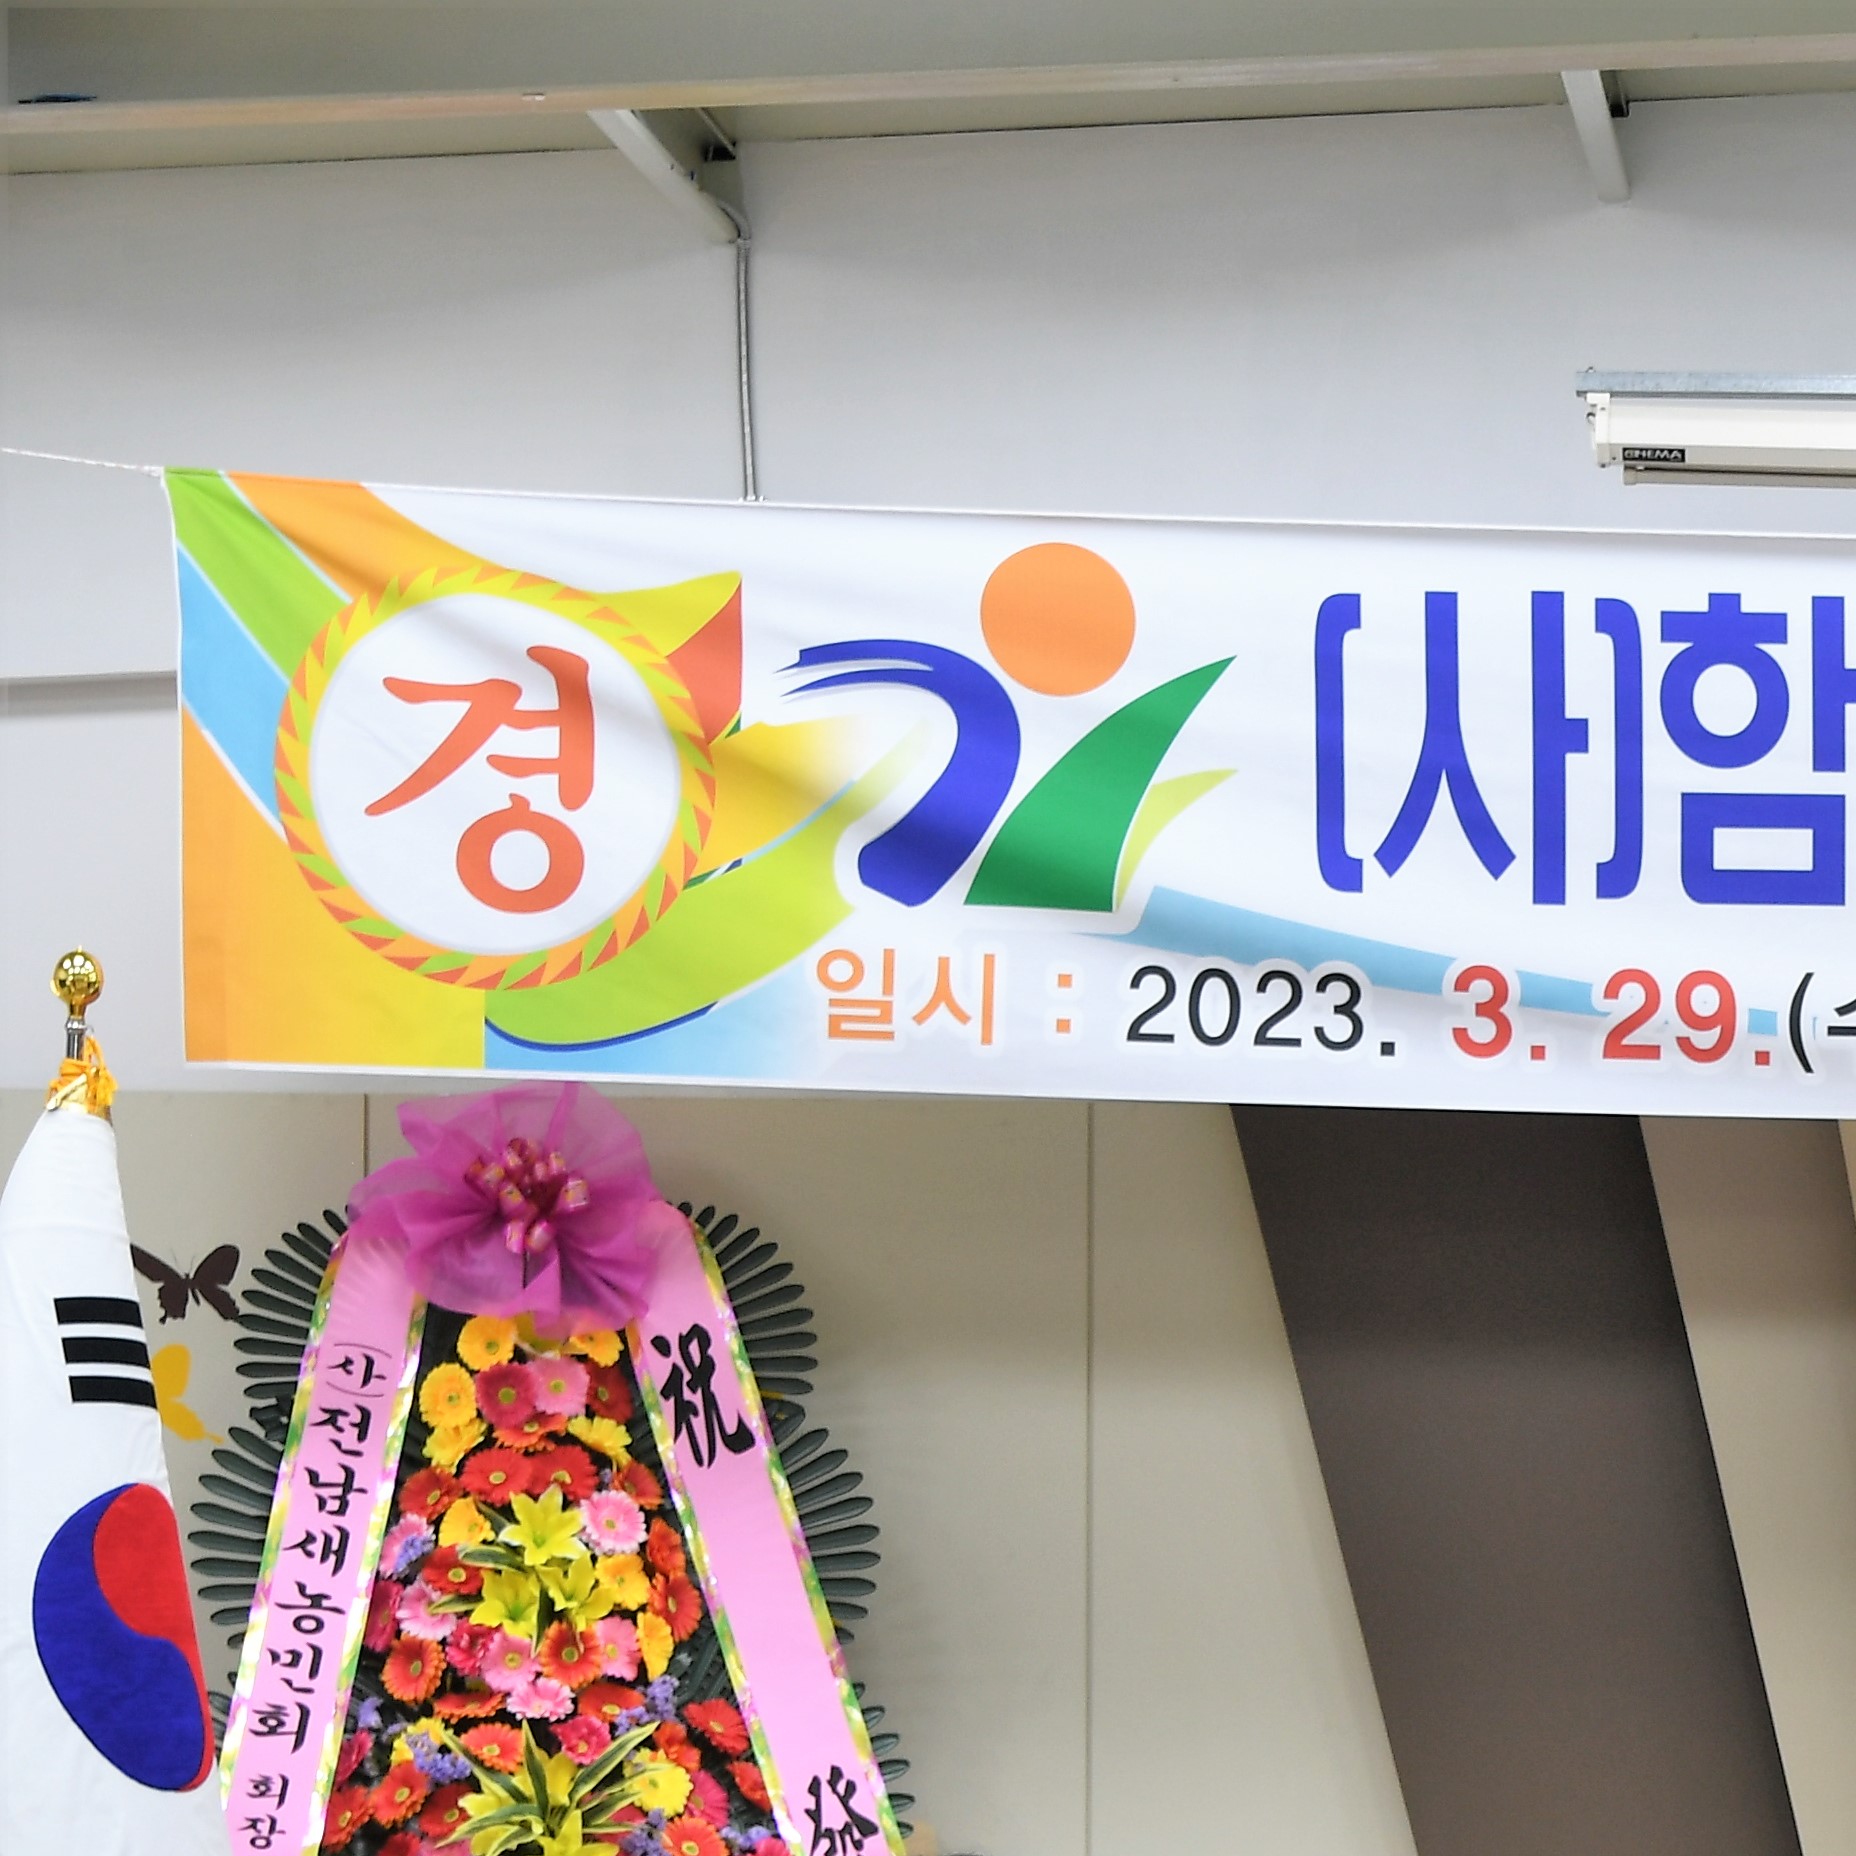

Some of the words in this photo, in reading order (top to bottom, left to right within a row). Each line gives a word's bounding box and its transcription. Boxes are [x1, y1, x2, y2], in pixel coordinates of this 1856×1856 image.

[366, 646, 595, 915] 경
[814, 947, 1002, 1046] 일시
[1125, 963, 1396, 1058] 2023.
[1452, 965, 1547, 1063] 3.
[650, 1323, 756, 1469] 祝
